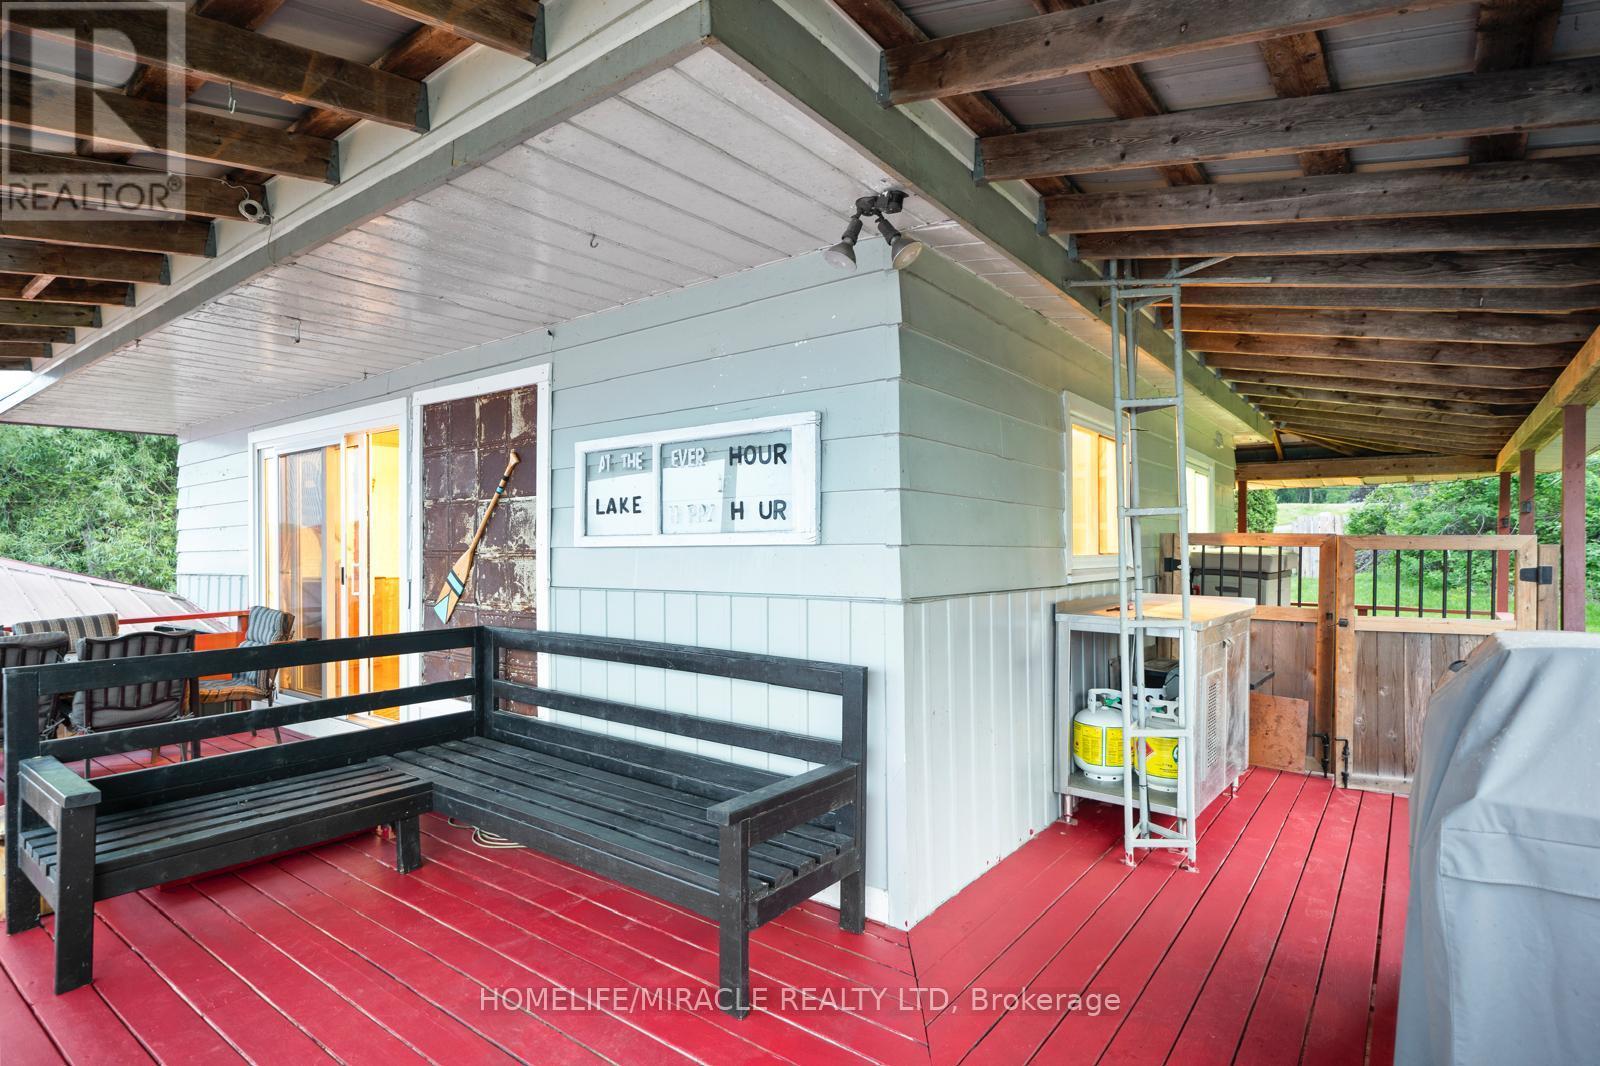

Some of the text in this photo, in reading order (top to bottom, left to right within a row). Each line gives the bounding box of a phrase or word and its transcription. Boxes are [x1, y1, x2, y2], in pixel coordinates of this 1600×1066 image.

[598, 451, 644, 473] AT THE
[671, 443, 787, 468] EVER HOUR
[595, 495, 642, 515] LAKE
